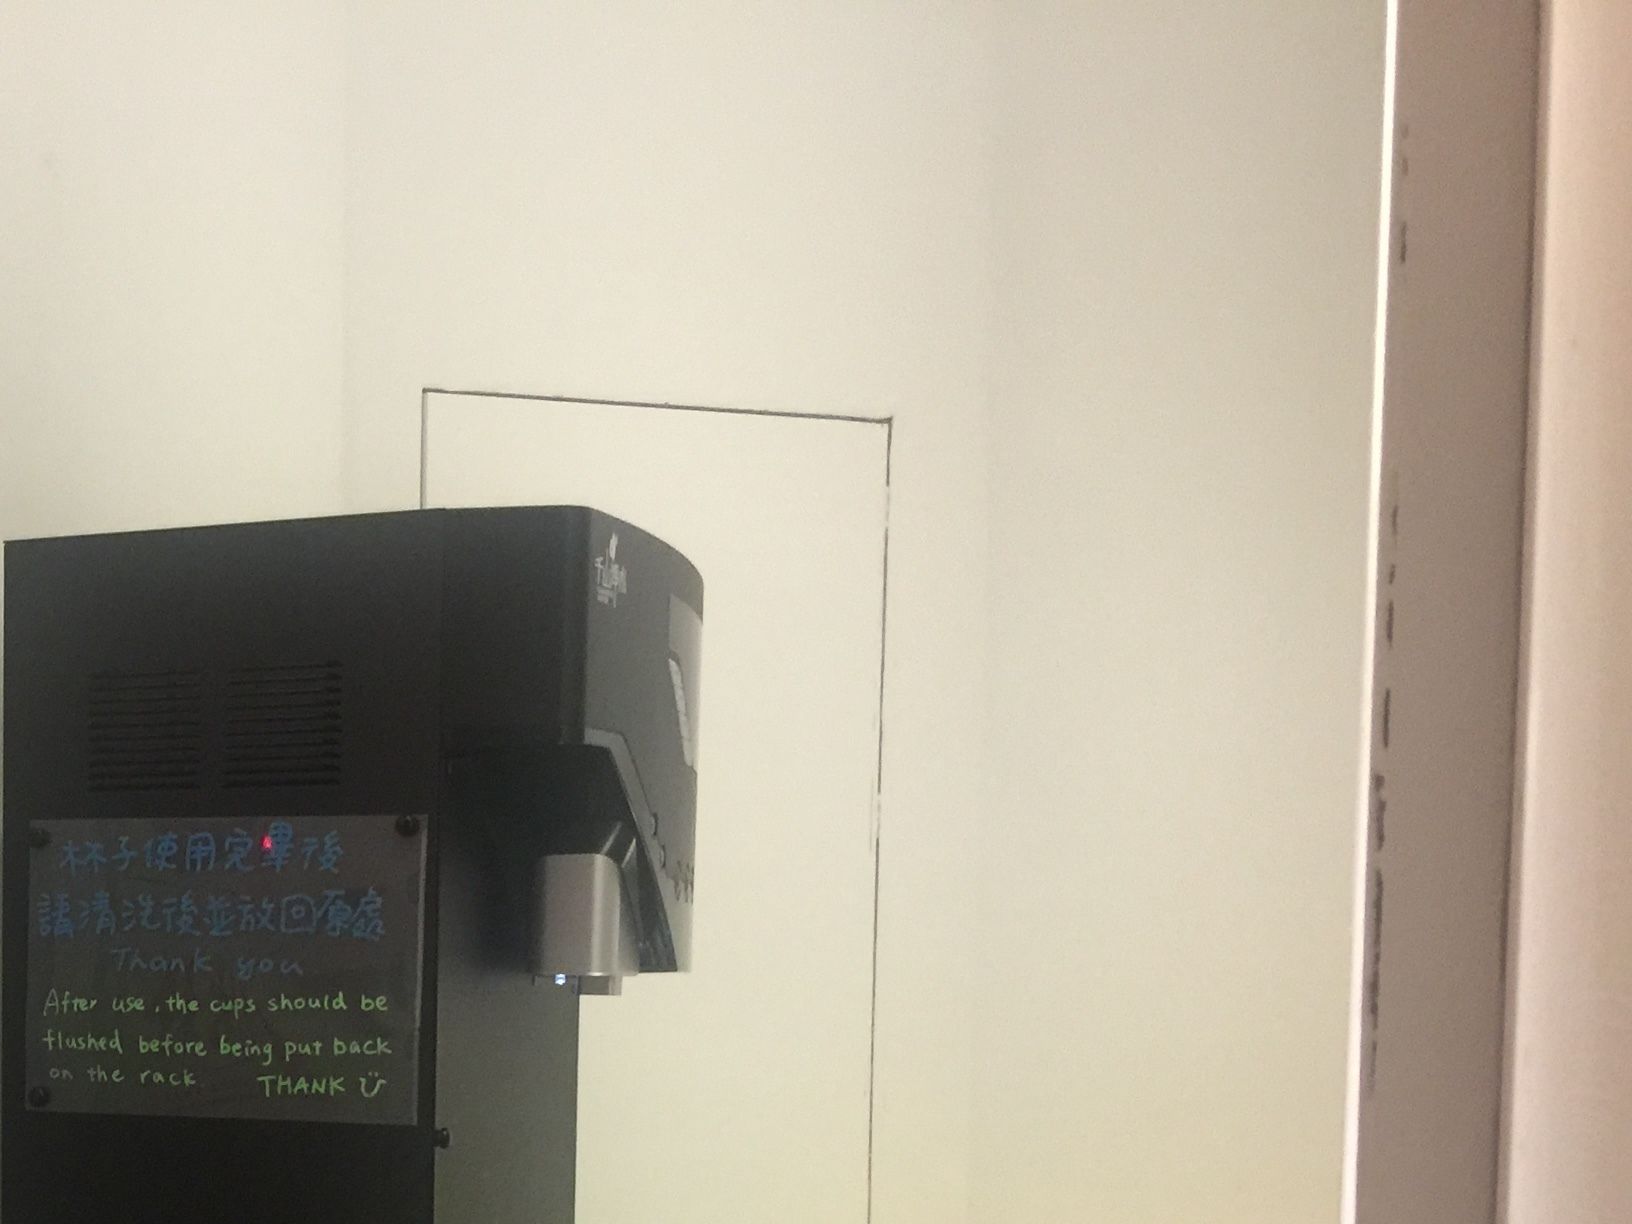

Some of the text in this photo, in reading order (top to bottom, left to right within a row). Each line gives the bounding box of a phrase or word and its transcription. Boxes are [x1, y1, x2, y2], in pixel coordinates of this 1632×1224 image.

[112, 948, 304, 980] Thank you
[44, 988, 97, 1017] After
[166, 990, 199, 1013] the
[210, 997, 256, 1020] cups
[268, 992, 346, 1012] should
[360, 993, 387, 1012] be
[42, 1028, 392, 1066] flushed before being put back
[49, 1066, 73, 1080] on
[86, 1062, 124, 1081] the
[140, 1068, 196, 1086] rack
[258, 1075, 345, 1097] THANK
